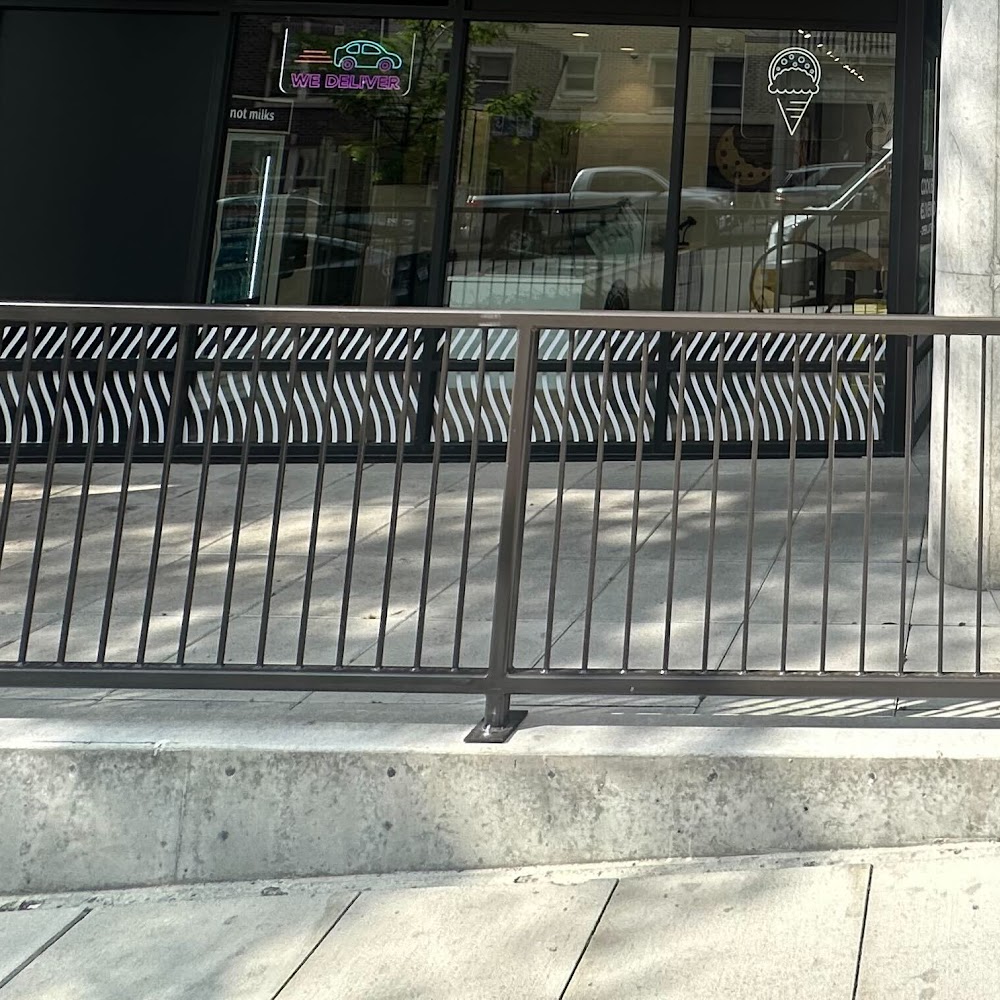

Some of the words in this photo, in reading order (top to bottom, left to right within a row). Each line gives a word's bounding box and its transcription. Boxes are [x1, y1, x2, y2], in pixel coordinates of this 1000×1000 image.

[290, 73, 320, 89] WE
[324, 74, 401, 91] DELIVER
[229, 107, 247, 120] not
[249, 108, 275, 122] milks
